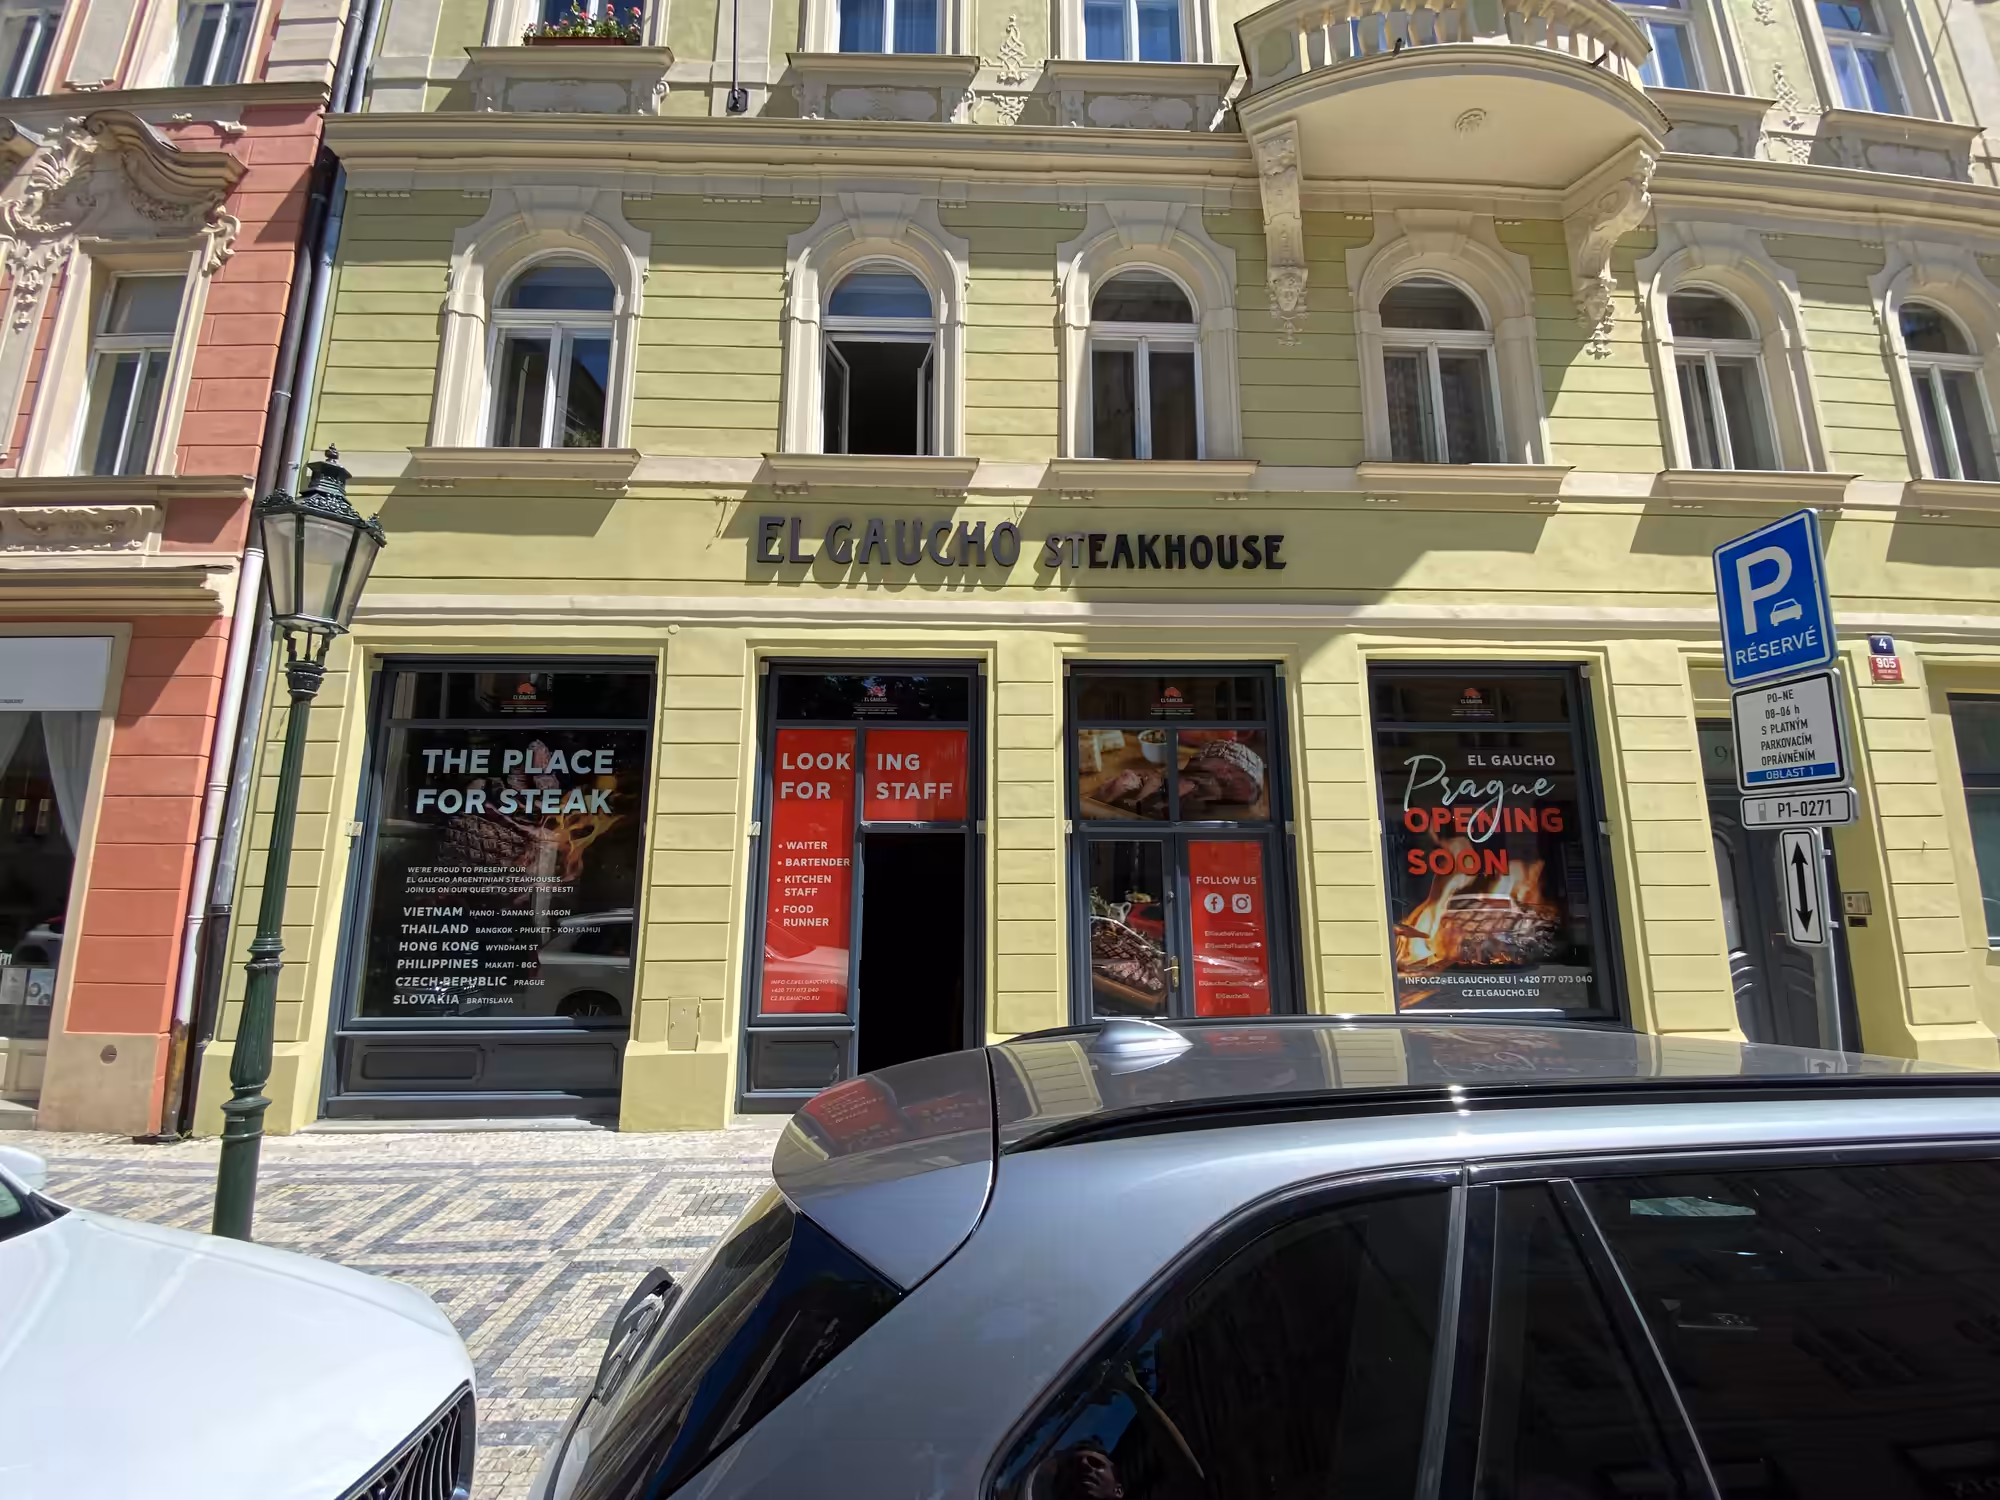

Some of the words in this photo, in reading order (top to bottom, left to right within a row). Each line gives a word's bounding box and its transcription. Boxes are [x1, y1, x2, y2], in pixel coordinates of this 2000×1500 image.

[757, 516, 814, 564] EL
[825, 520, 1021, 568] GAUCHO
[1045, 533, 1287, 570] STEAKHOUSE
[1736, 546, 1792, 636] P
[1735, 625, 1818, 666] RÉSERVÉ
[1879, 638, 1887, 649] 4
[1876, 657, 1897, 669] 905
[1767, 689, 1794, 704] PO-NE
[1765, 707, 1791, 719] 08-06
[1794, 705, 1800, 715] h
[1761, 725, 1767, 736] S
[1770, 717, 1808, 734] PLATNÝM
[1760, 732, 1813, 751] PARKOVACÍM
[422, 749, 490, 774] THE
[503, 749, 615, 774] PLACE
[782, 752, 851, 770] LOOK
[877, 753, 920, 771] ING
[1467, 755, 1486, 766] EL
[1491, 755, 1556, 766] GAUCHO
[1761, 748, 1816, 767] OPRÁVNĚNÍM
[1766, 767, 1805, 780] OBLAST
[781, 781, 831, 799] FOR
[876, 782, 953, 800] STAFF
[415, 789, 486, 814] FOR
[499, 789, 612, 814] STEAK
[1403, 754, 1556, 843] Prague
[1777, 799, 1832, 818] P1-0271
[1404, 807, 1564, 833] OPENING
[786, 841, 828, 850] WAITER
[785, 858, 850, 867] BARTENDER
[1407, 848, 1509, 875] SOON
[784, 875, 832, 884] KITCHEN
[1196, 876, 1240, 885] FOLLOW
[1243, 876, 1257, 885] US
[784, 888, 818, 897] STAFF
[403, 907, 463, 917] VIETNAM
[783, 905, 814, 914] FOOD
[401, 924, 469, 934] THAILAND
[783, 918, 829, 927] RUNNER
[399, 941, 437, 951] HONG
[441, 941, 479, 951] KONG
[397, 959, 479, 969] PHILIPPINES
[395, 976, 438, 987] CZECH
[441, 976, 508, 987] REPUBLIC
[1405, 976, 1511, 985] INFO.CZ@ELGAUCHO.EU
[1519, 976, 1540, 984] +420
[393, 994, 460, 1005] SLOVAKIA
[1462, 989, 1540, 997] CZ.ELGAUCHO.EU
